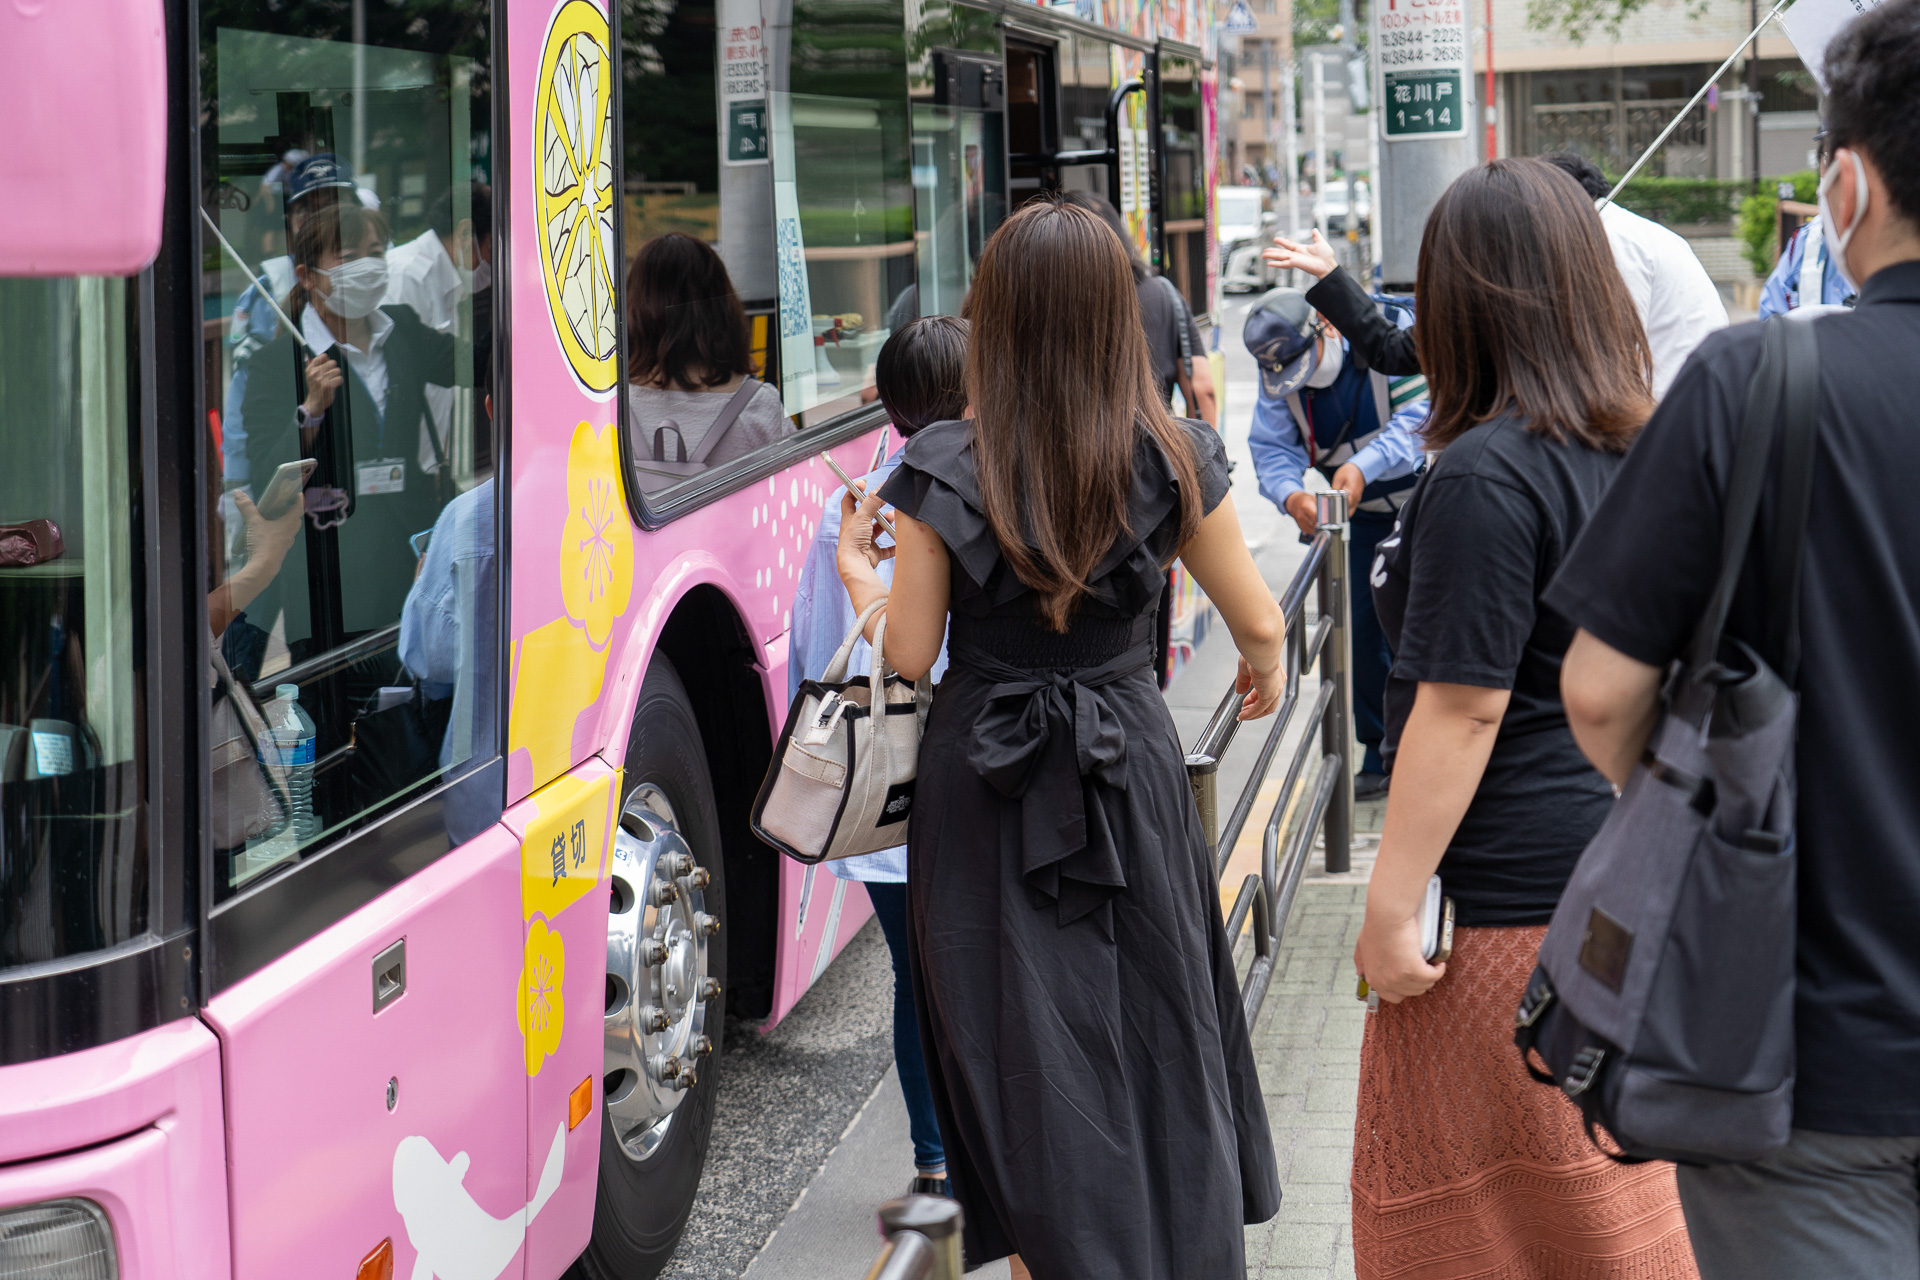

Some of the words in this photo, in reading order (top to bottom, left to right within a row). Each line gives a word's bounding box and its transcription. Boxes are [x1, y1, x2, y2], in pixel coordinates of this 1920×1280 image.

[1394, 82, 1453, 103] 花川戸
[1396, 107, 1451, 127] 1-14
[551, 819, 585, 888] 貸切
